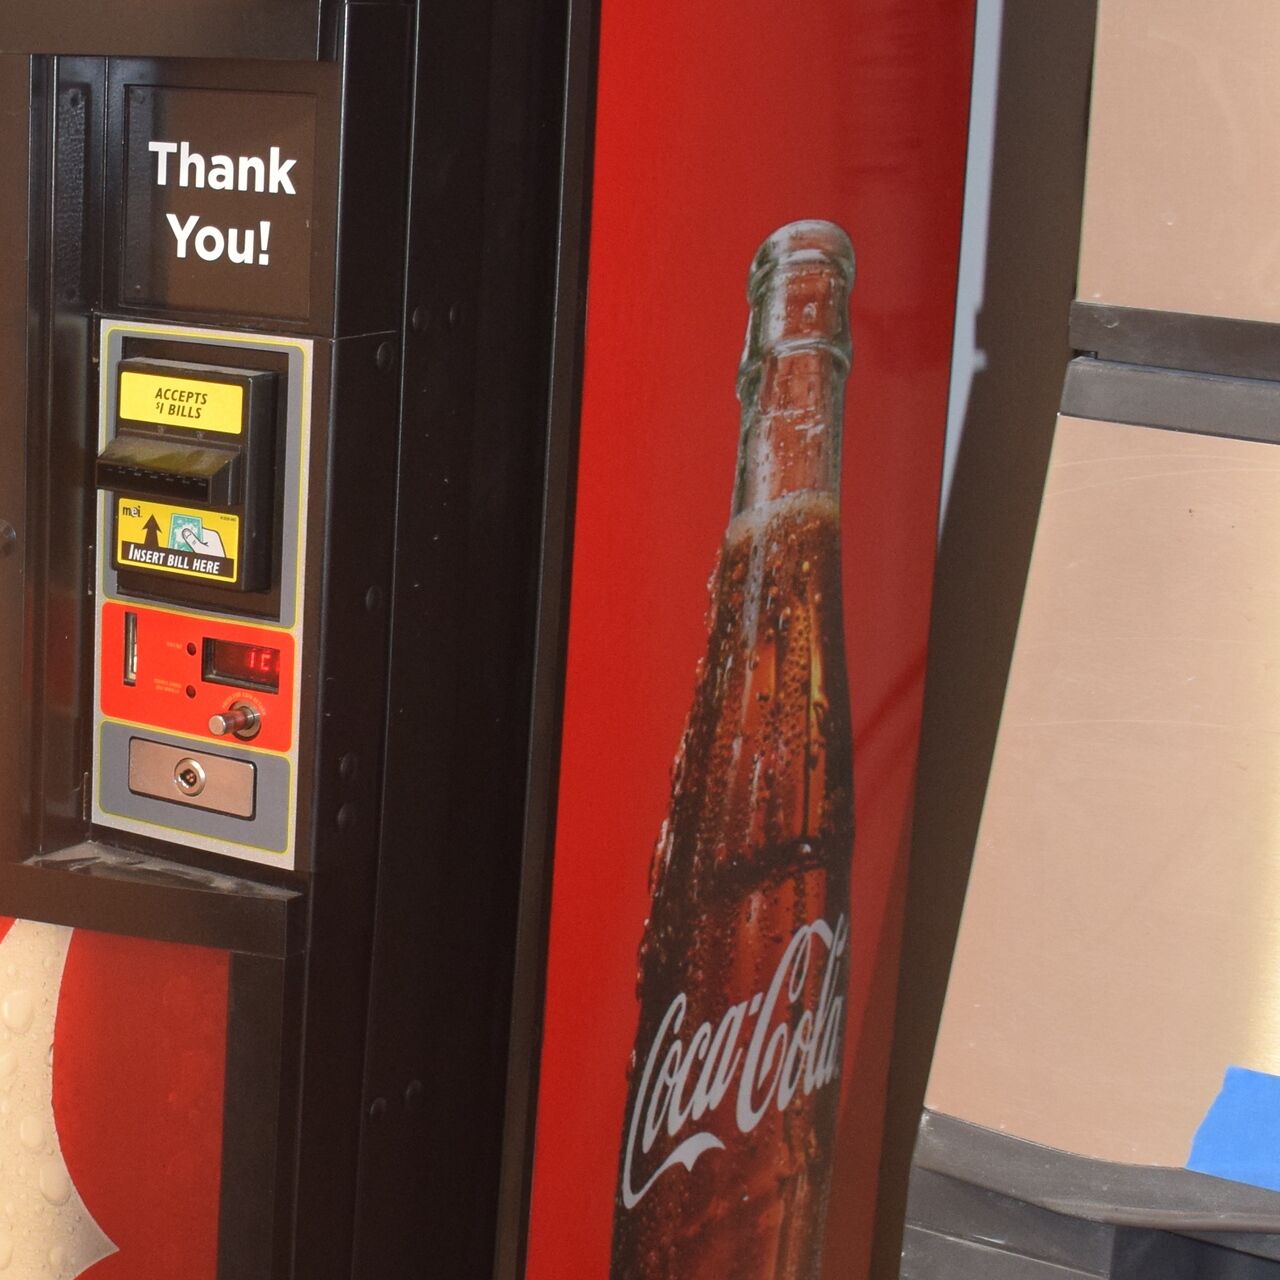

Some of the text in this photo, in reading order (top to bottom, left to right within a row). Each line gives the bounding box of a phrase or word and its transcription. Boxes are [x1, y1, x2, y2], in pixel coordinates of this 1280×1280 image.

[148, 141, 297, 195] Thank
[166, 213, 270, 266] You!
[155, 388, 208, 405] ACCEPTS
[168, 403, 202, 419] BILLS
[167, 553, 189, 570] BILL
[193, 557, 220, 574] HERE
[621, 912, 849, 1209] Coca-Cola
